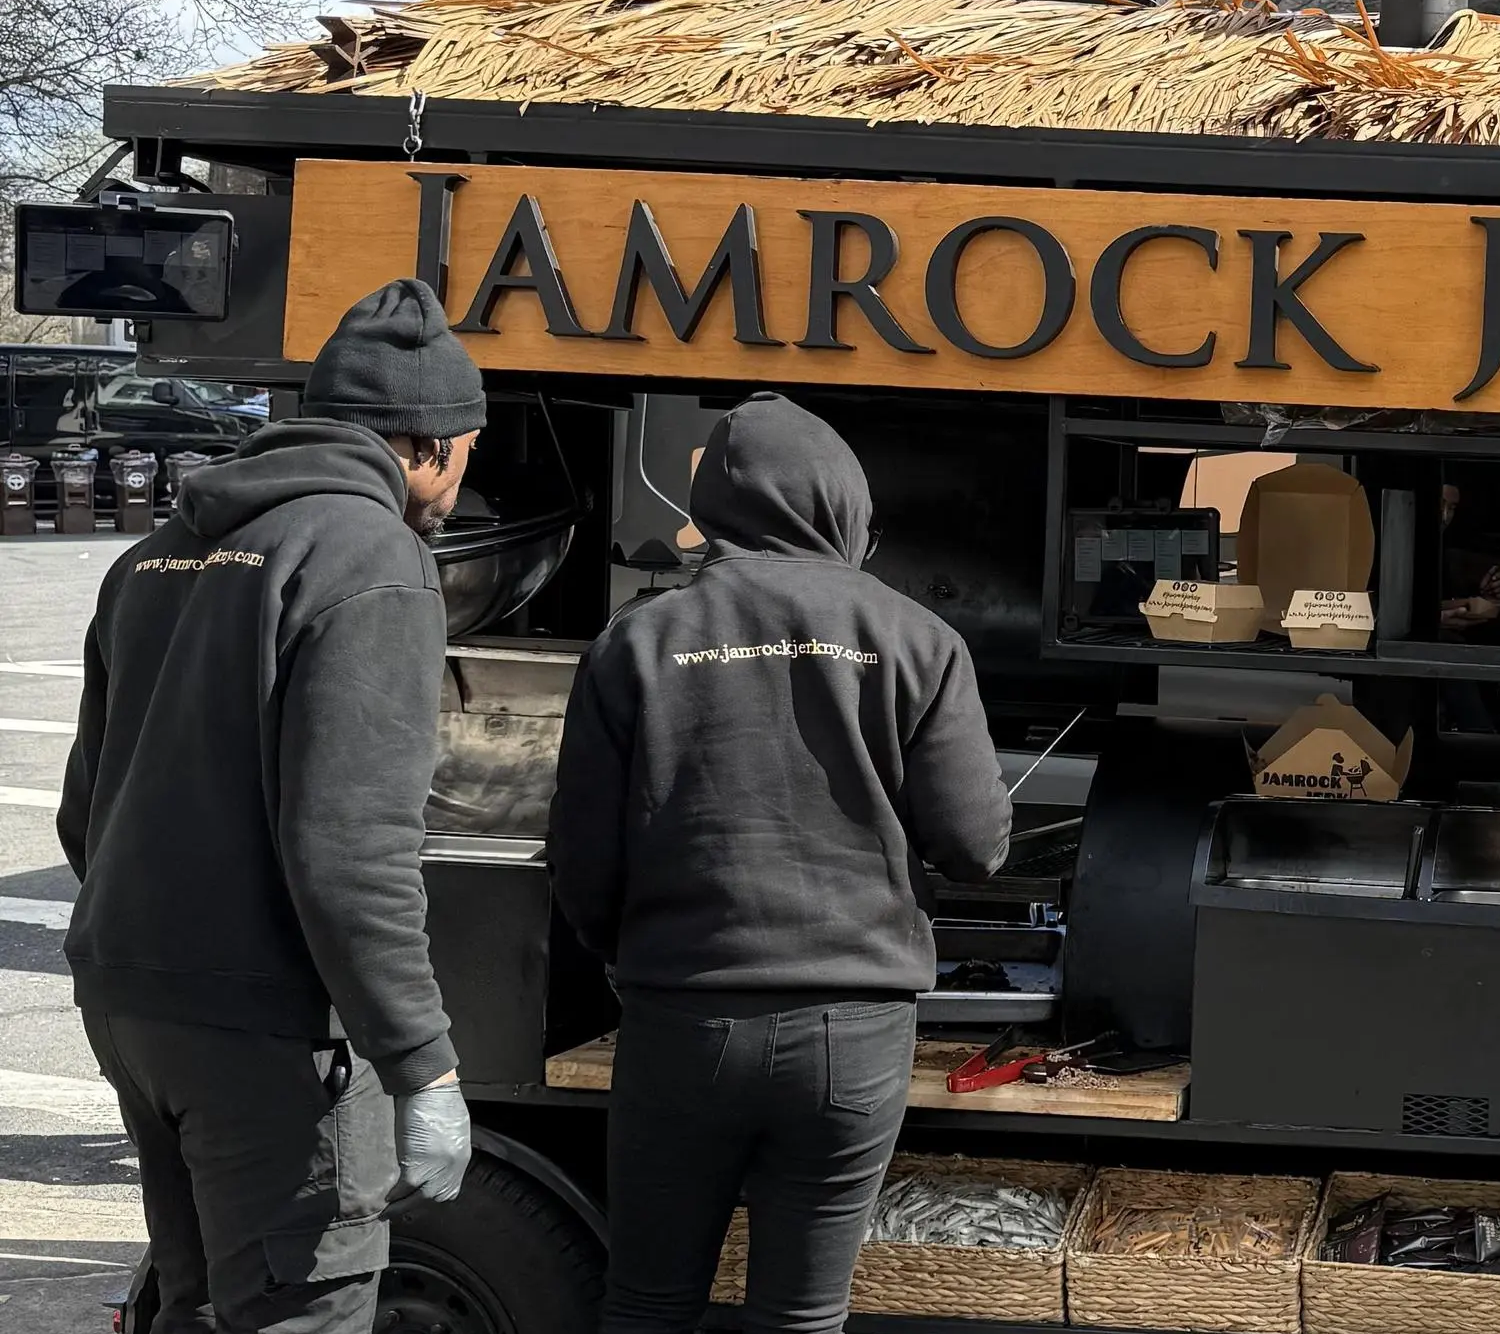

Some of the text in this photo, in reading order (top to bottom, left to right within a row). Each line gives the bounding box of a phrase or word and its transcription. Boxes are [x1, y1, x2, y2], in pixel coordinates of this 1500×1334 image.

[402, 172, 1380, 375] JAMROCK
[673, 639, 878, 666] www.jamrockjerkny.com
[1261, 771, 1342, 789] JAMROCK
